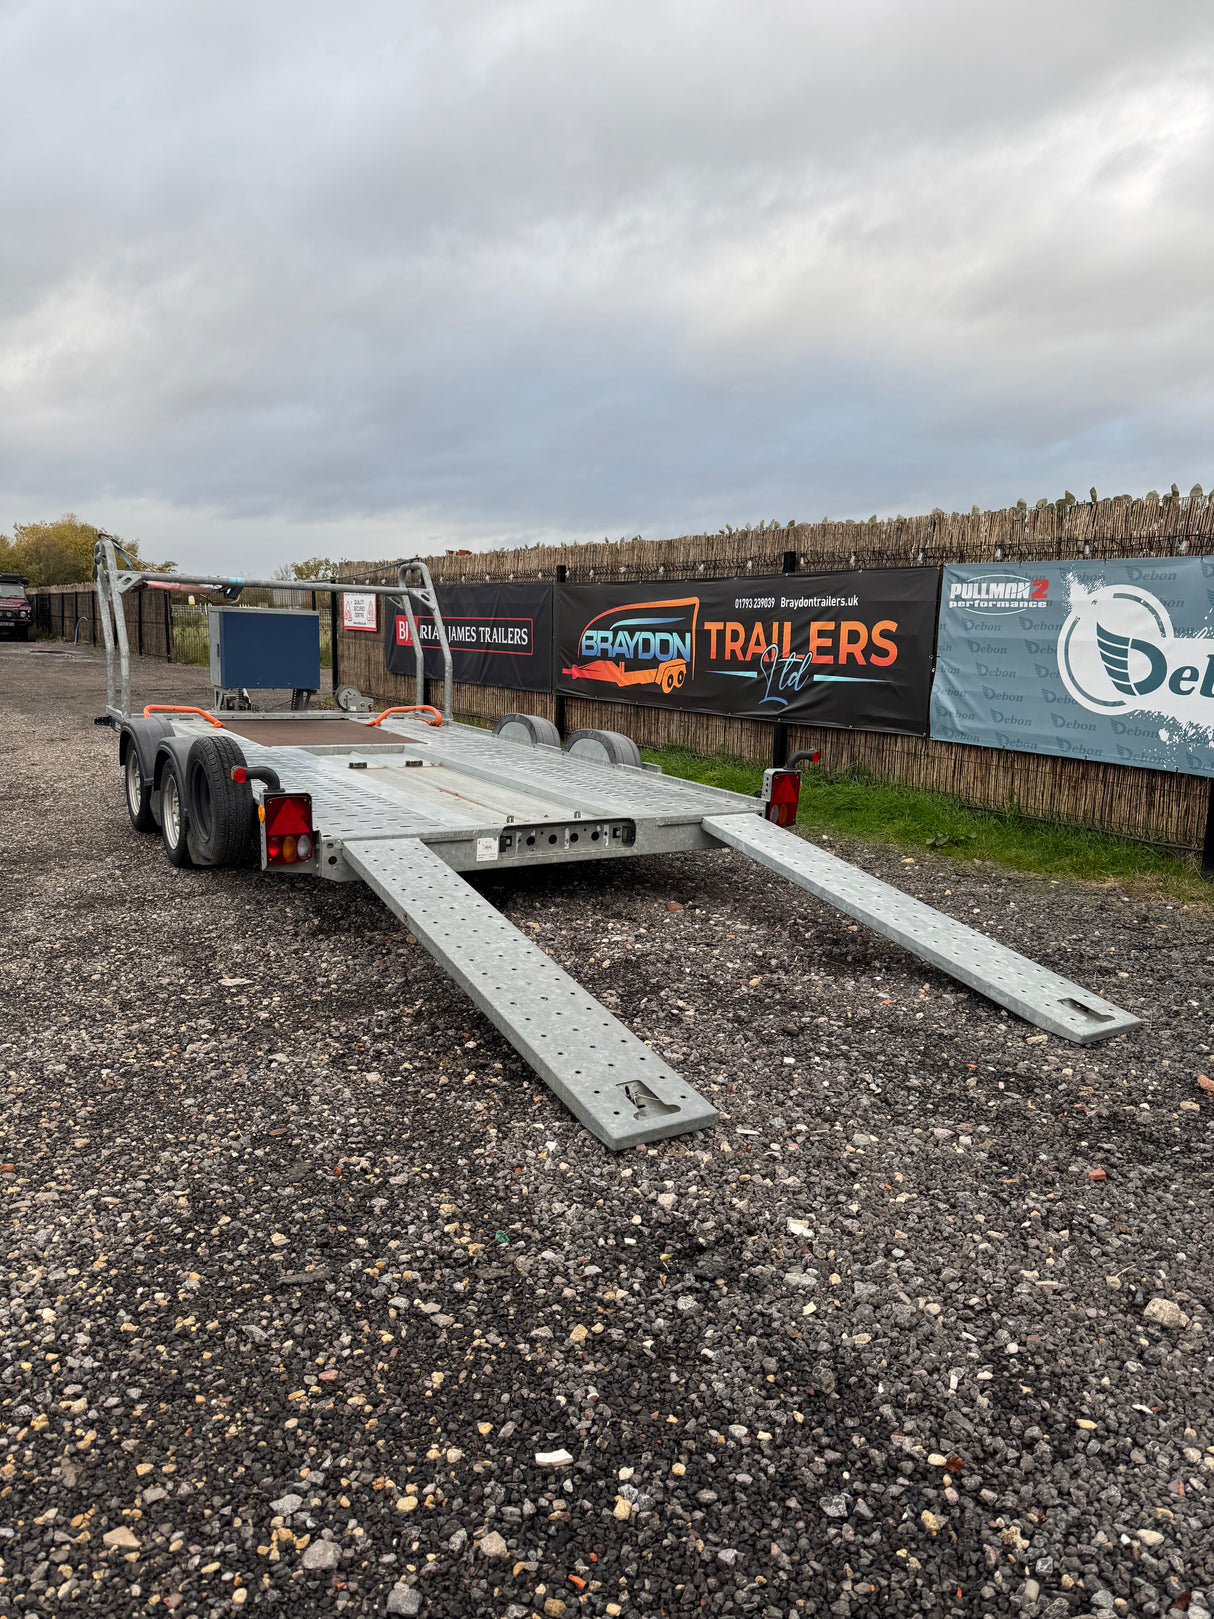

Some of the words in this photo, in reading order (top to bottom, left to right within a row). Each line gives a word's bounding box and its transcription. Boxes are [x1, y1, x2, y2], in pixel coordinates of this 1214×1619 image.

[1126, 565, 1177, 582] Debon
[734, 597, 753, 608] 01793
[753, 597, 775, 608] 239039
[780, 594, 859, 610] Braydontrailers.uk
[949, 600, 1047, 608] performance
[961, 616, 1002, 632] Debon
[448, 625, 477, 643] JAMES
[478, 626, 529, 645] TRAILERS
[703, 619, 899, 667] TRAILERS
[581, 629, 692, 662] BRAYDON
[966, 638, 1008, 654] Debon
[758, 643, 813, 706] Ltd
[975, 660, 1017, 678] Debon
[982, 684, 1024, 702] Debon
[990, 707, 1033, 726] Debon
[1050, 711, 1097, 731] Debon
[995, 730, 1039, 750] Debon
[1056, 735, 1103, 756] Debon
